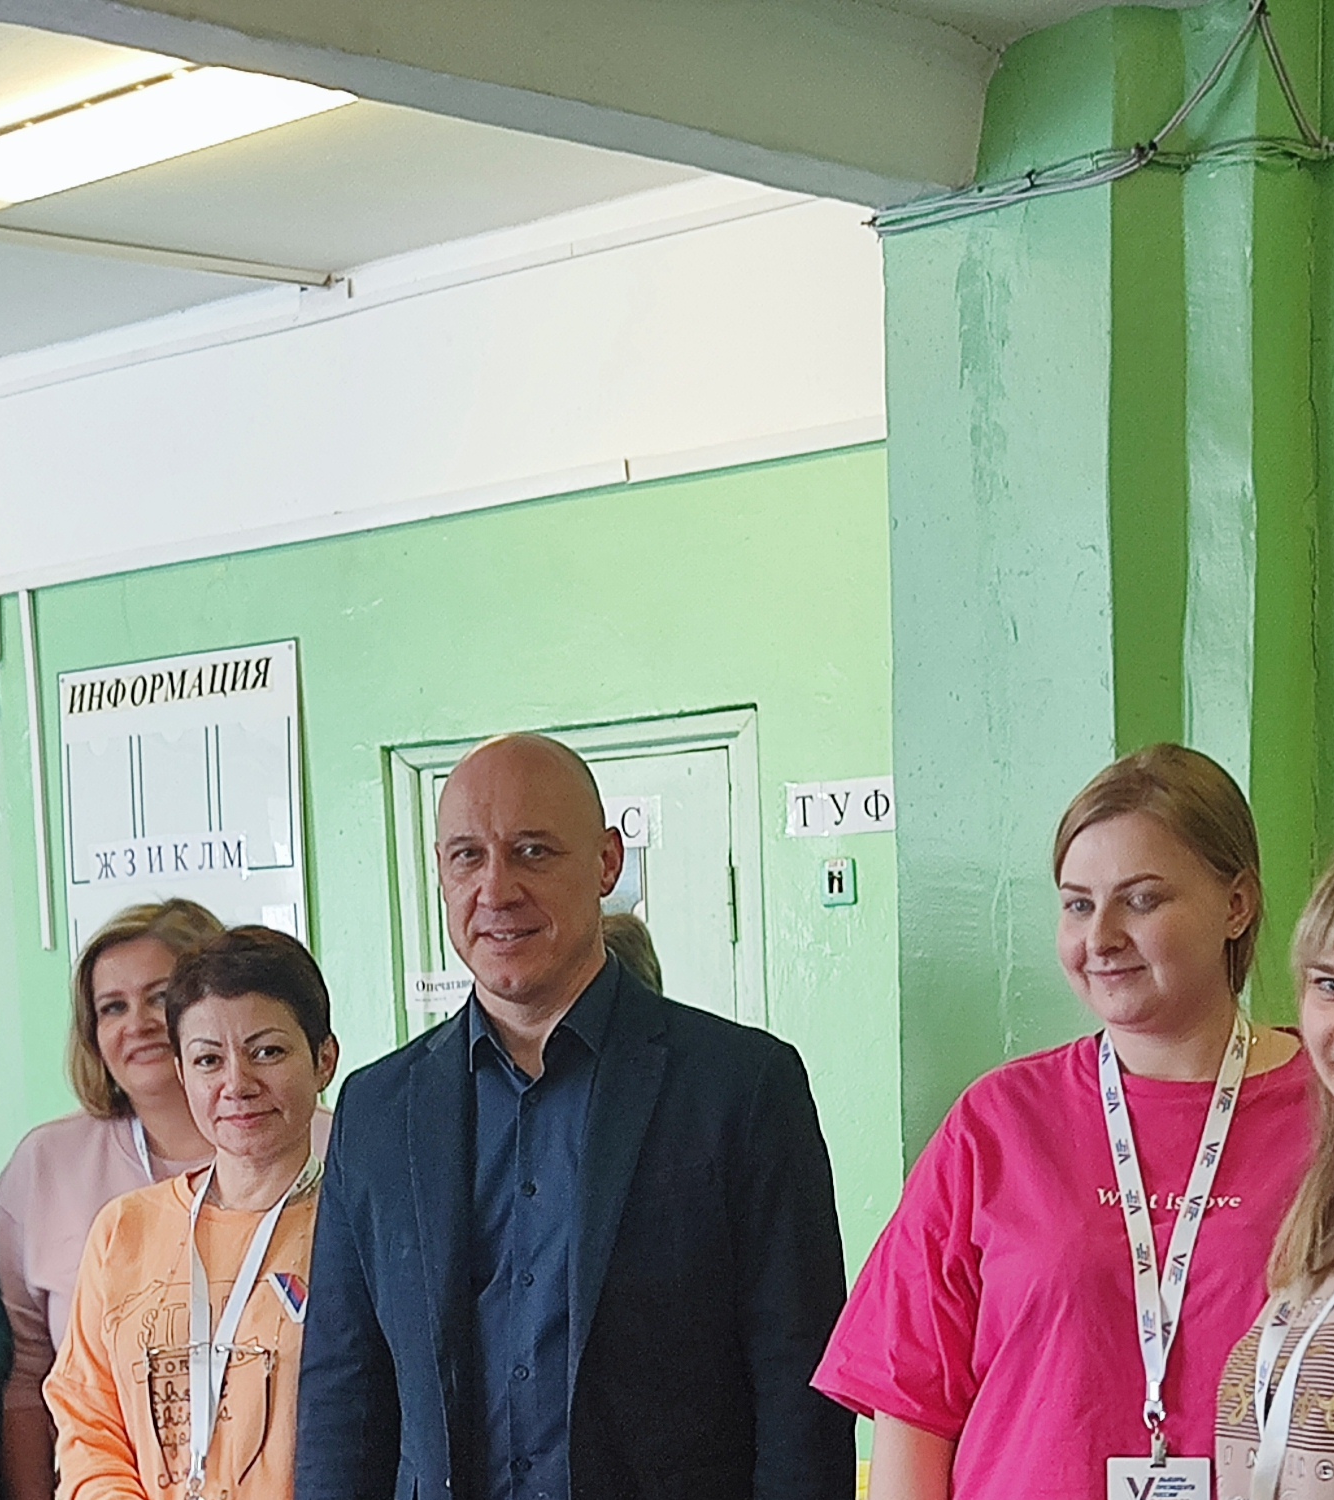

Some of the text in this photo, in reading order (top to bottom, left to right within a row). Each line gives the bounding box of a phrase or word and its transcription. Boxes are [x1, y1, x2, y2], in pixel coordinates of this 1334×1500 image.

[68, 657, 272, 714] ИНФОРМАЦИЯ
[1097, 1187, 1158, 1210] Wt
[1207, 1194, 1243, 1210] ove
